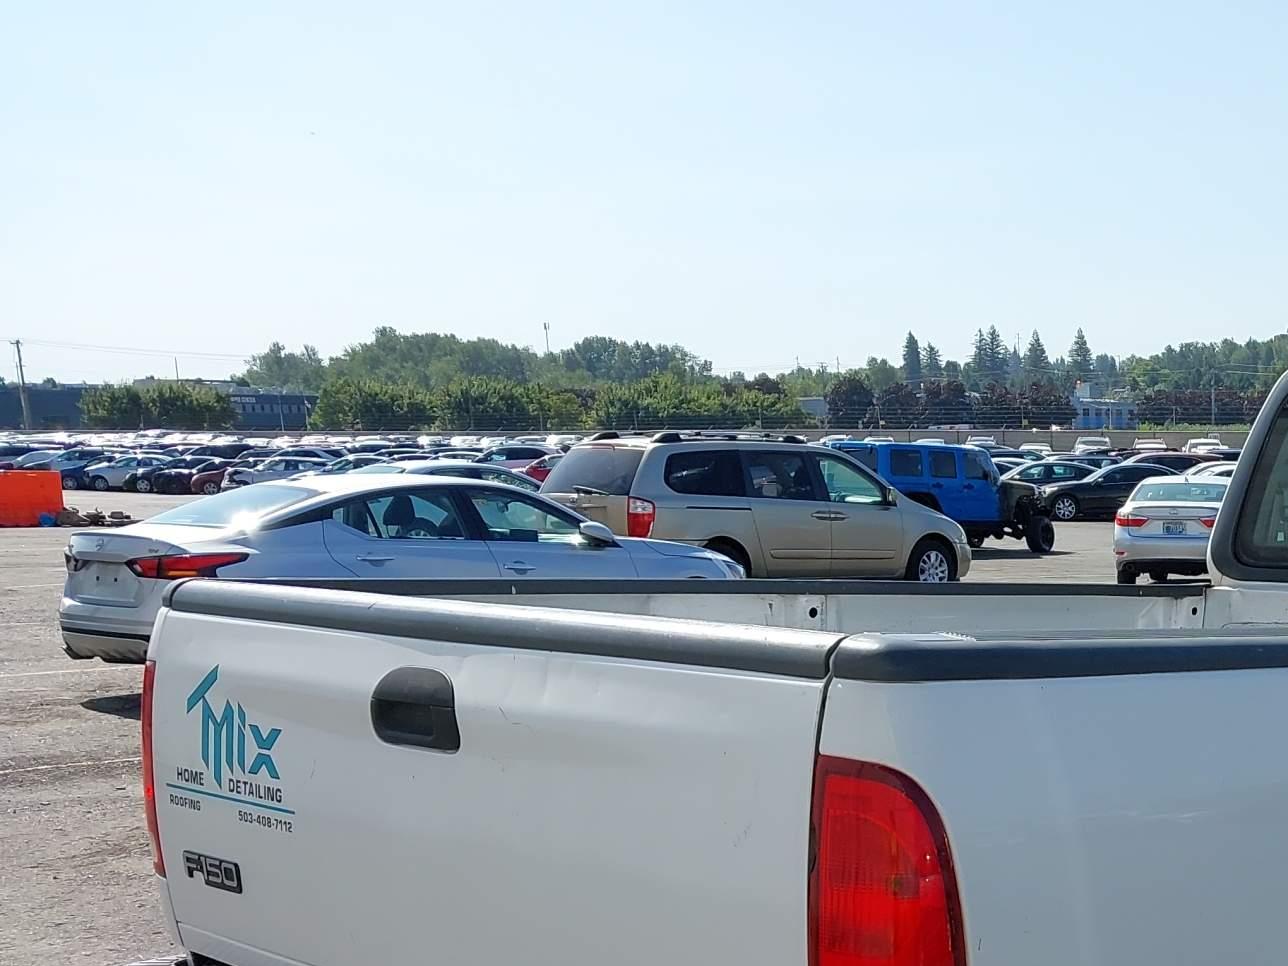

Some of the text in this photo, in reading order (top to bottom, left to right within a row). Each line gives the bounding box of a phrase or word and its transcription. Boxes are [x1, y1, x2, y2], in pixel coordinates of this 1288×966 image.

[177, 766, 283, 803] HOME DETAILING
[169, 793, 201, 811] ROOFING
[238, 810, 293, 833] 503-408-7112
